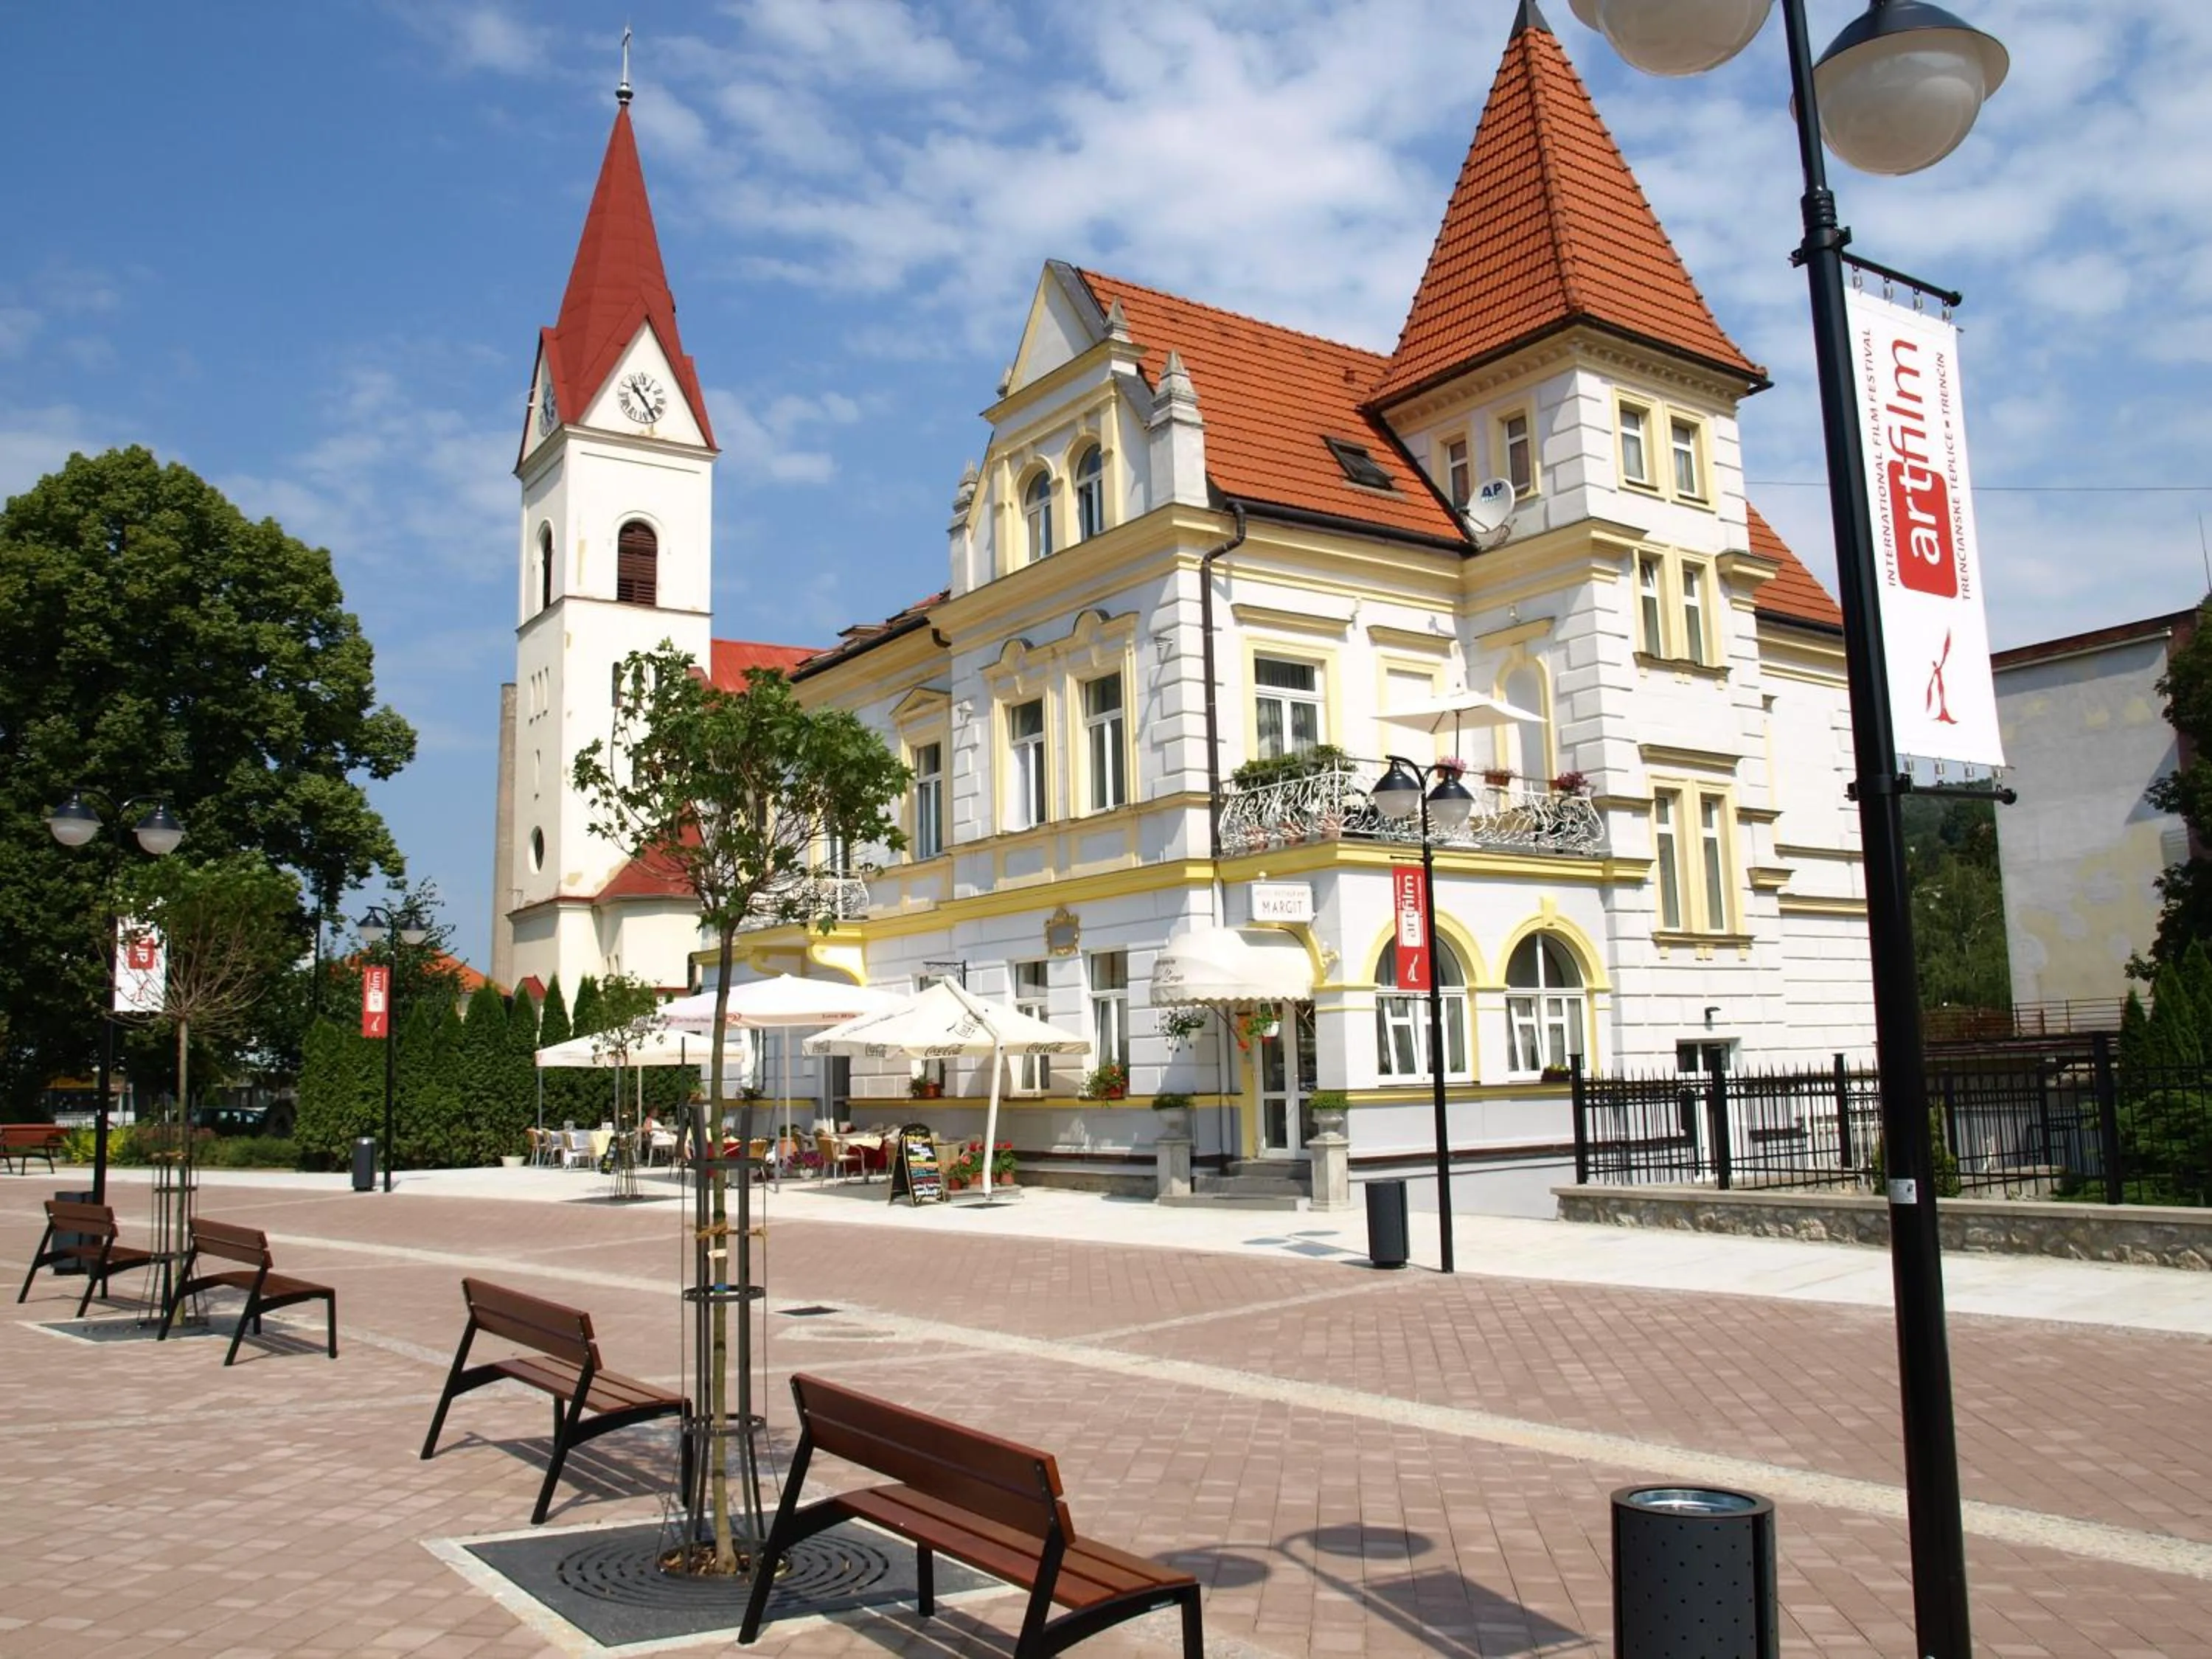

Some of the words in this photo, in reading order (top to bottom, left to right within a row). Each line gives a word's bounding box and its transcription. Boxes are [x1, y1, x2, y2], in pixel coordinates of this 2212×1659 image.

[1862, 328, 1877, 403] FESTIVAL
[1869, 407, 1882, 446] FILM
[1947, 433, 1959, 490] TEPLICE
[1875, 453, 1896, 587] INTERNATIONAL
[1952, 497, 1971, 600] TRENČIANSKE
